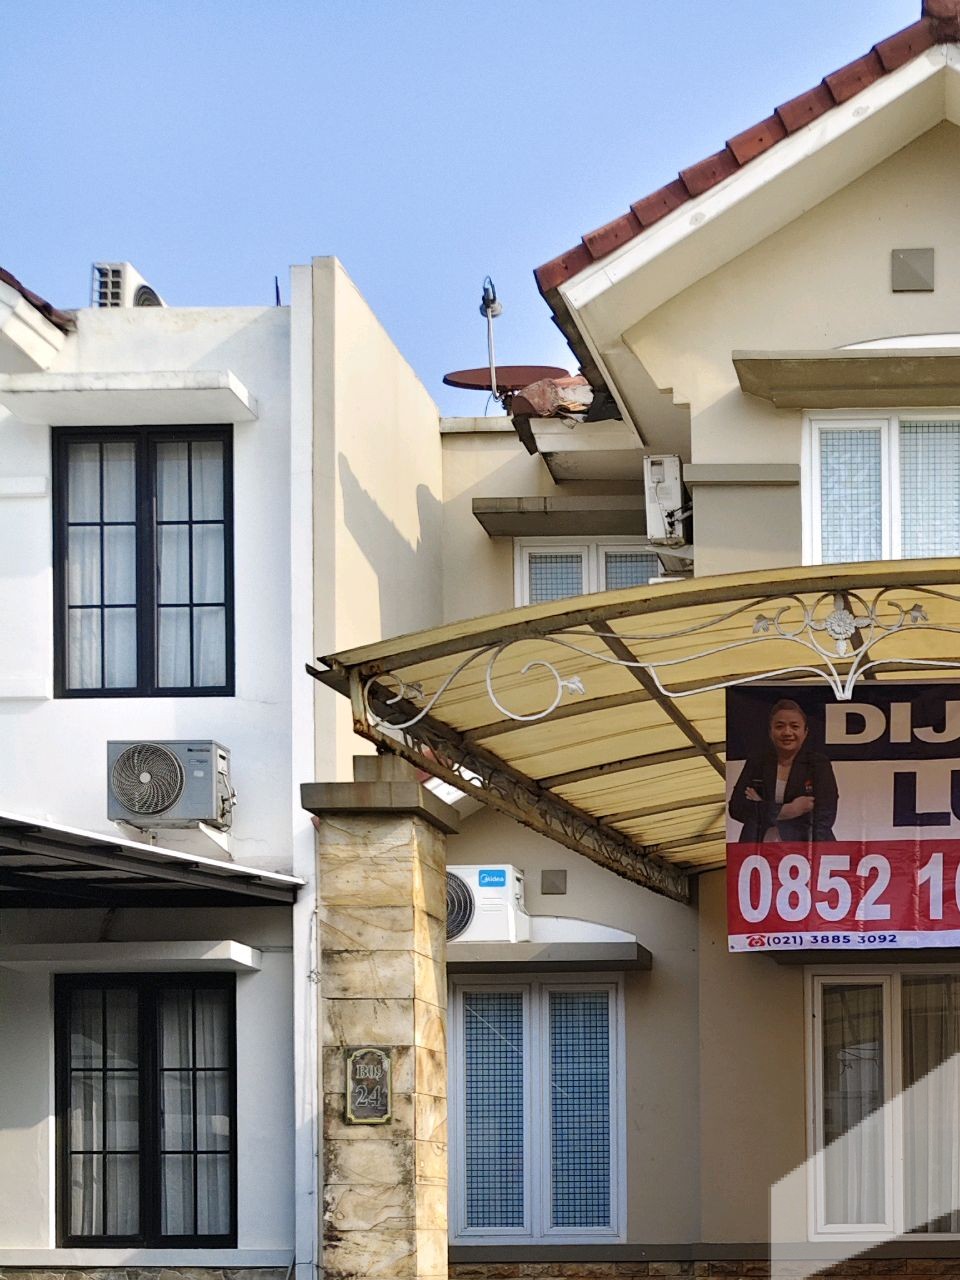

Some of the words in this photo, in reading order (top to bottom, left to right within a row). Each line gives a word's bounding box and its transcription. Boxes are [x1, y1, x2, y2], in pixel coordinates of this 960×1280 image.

[737, 853, 892, 923] 0852
[766, 935, 804, 946] (021)
[810, 935, 851, 944] 3885
[857, 934, 898, 944] 3092
[355, 1084, 382, 1107] 24
